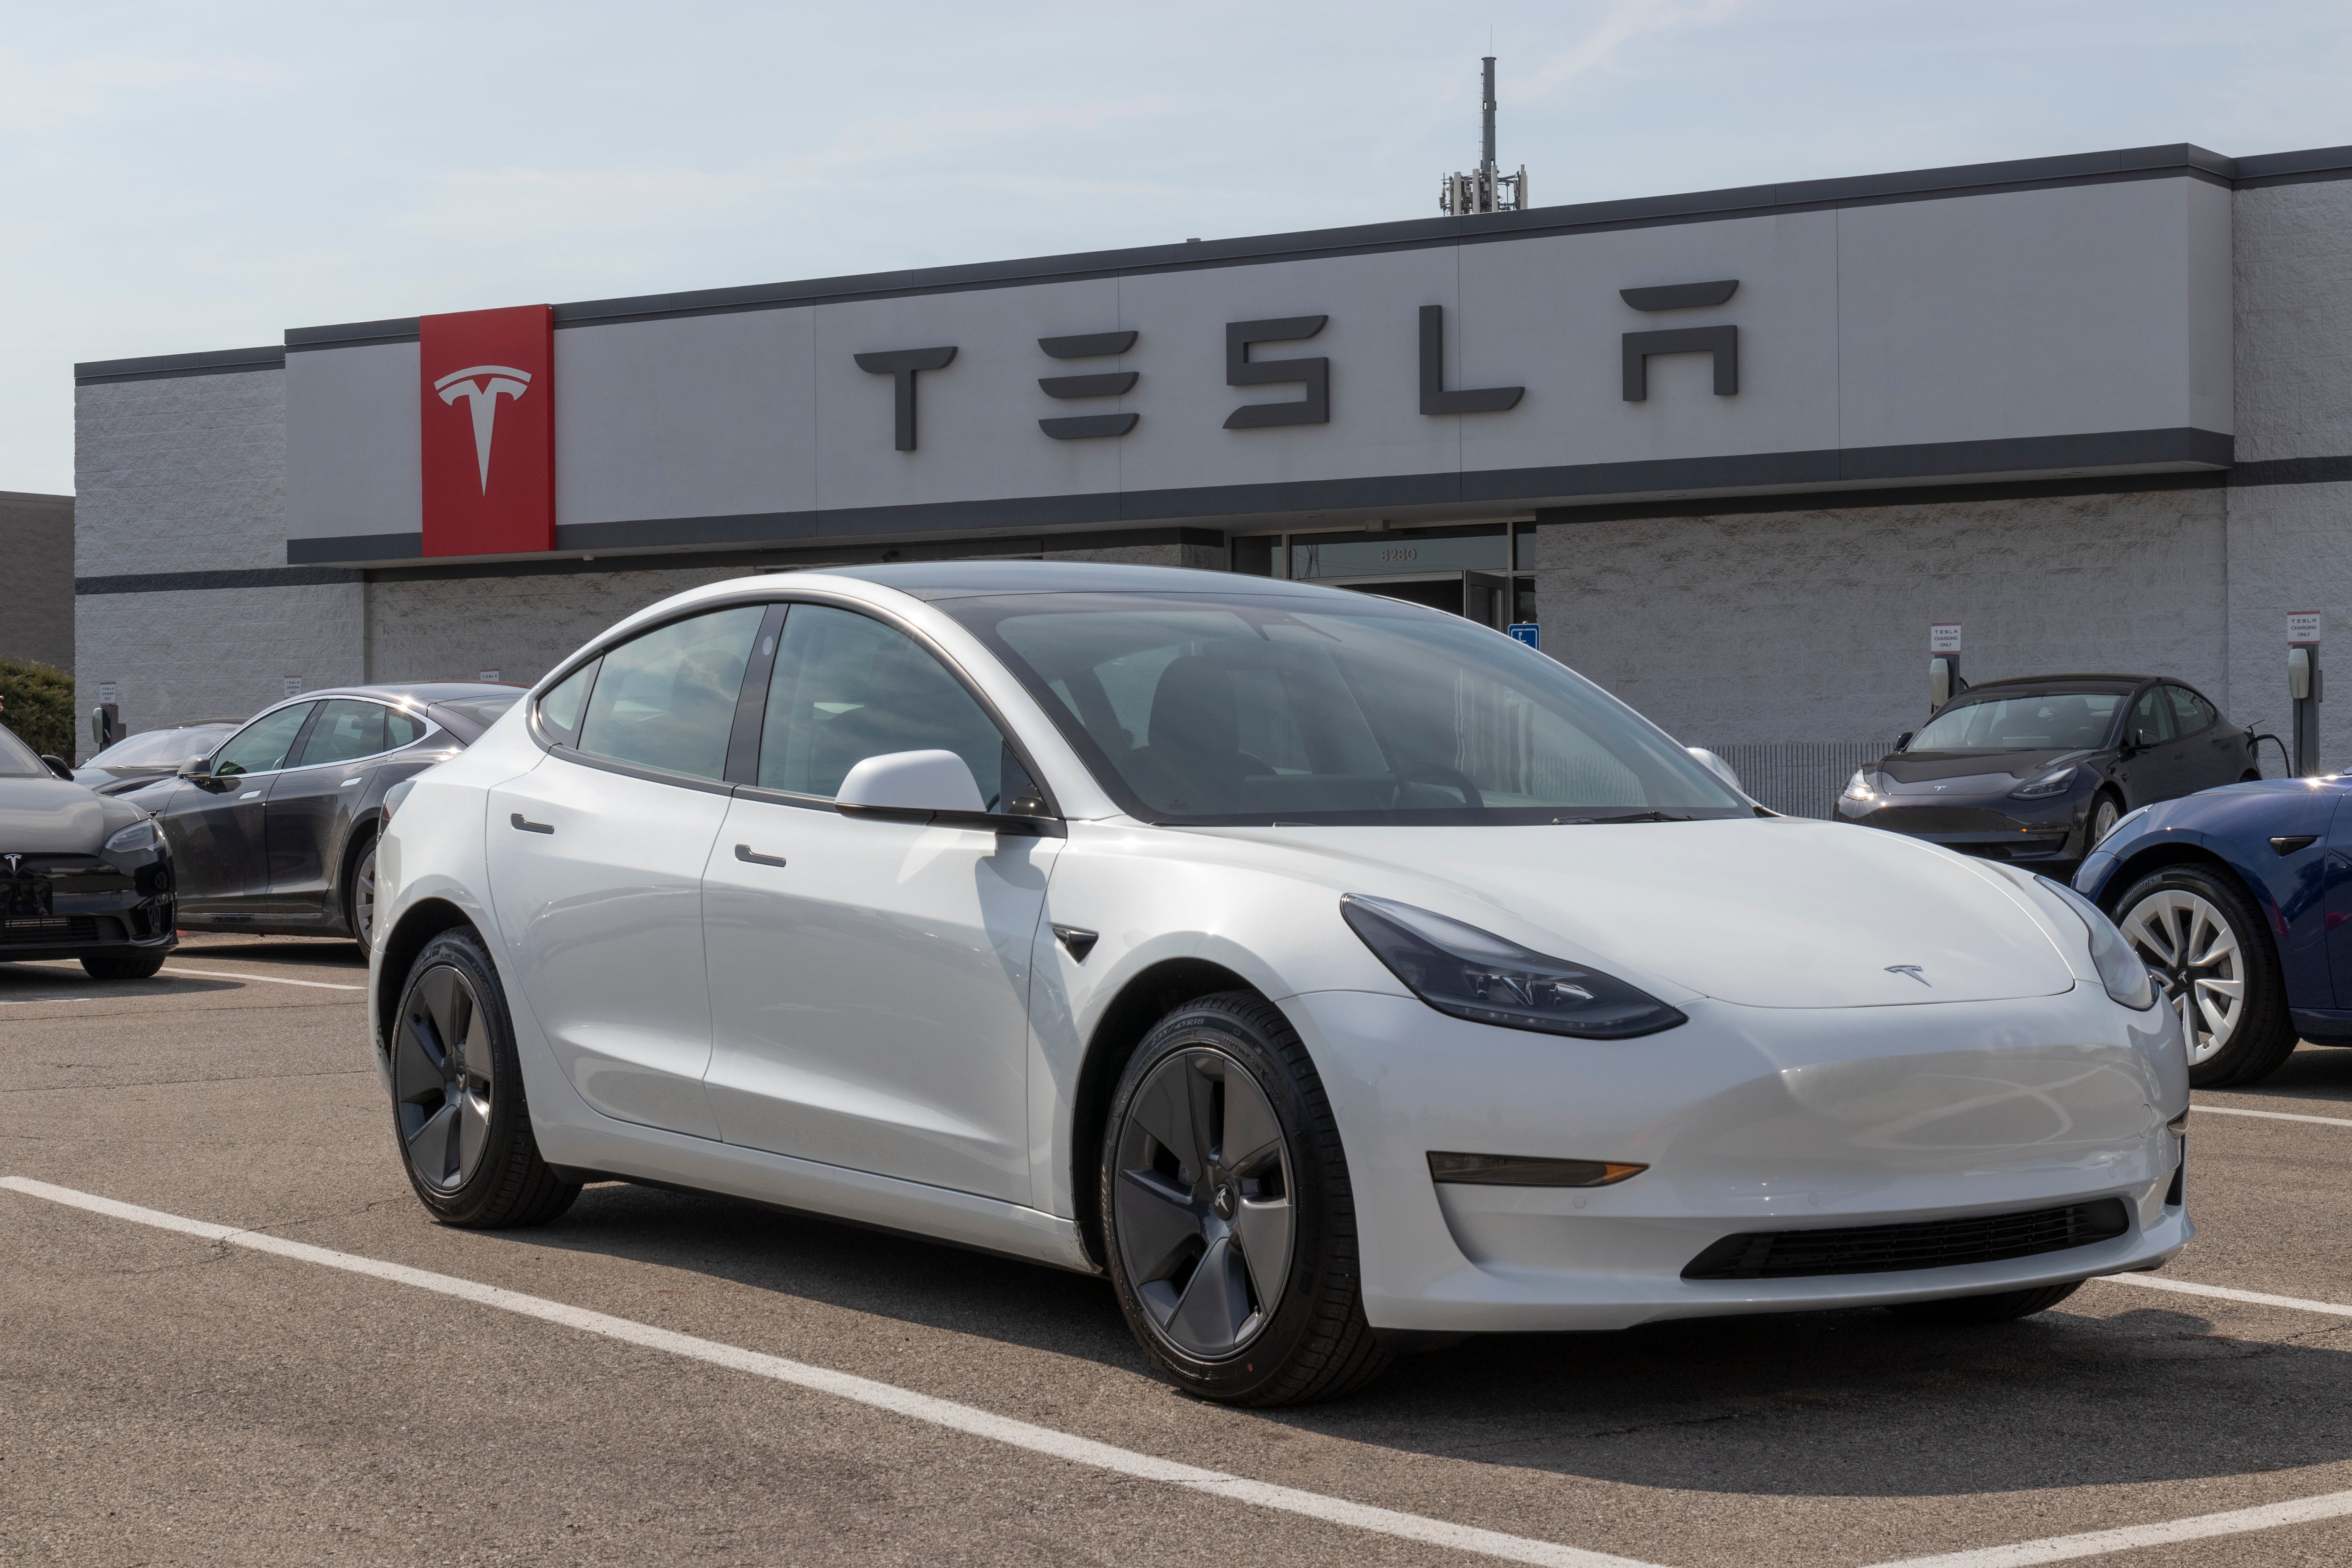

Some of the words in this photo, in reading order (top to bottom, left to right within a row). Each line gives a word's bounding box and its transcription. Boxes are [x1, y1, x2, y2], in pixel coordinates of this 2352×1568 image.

[853, 279, 1740, 451] TESLA
[1381, 548, 1417, 562] 8280
[2122, 879, 2150, 906] Continental
[1151, 1018, 1205, 1047] 235/45R18
